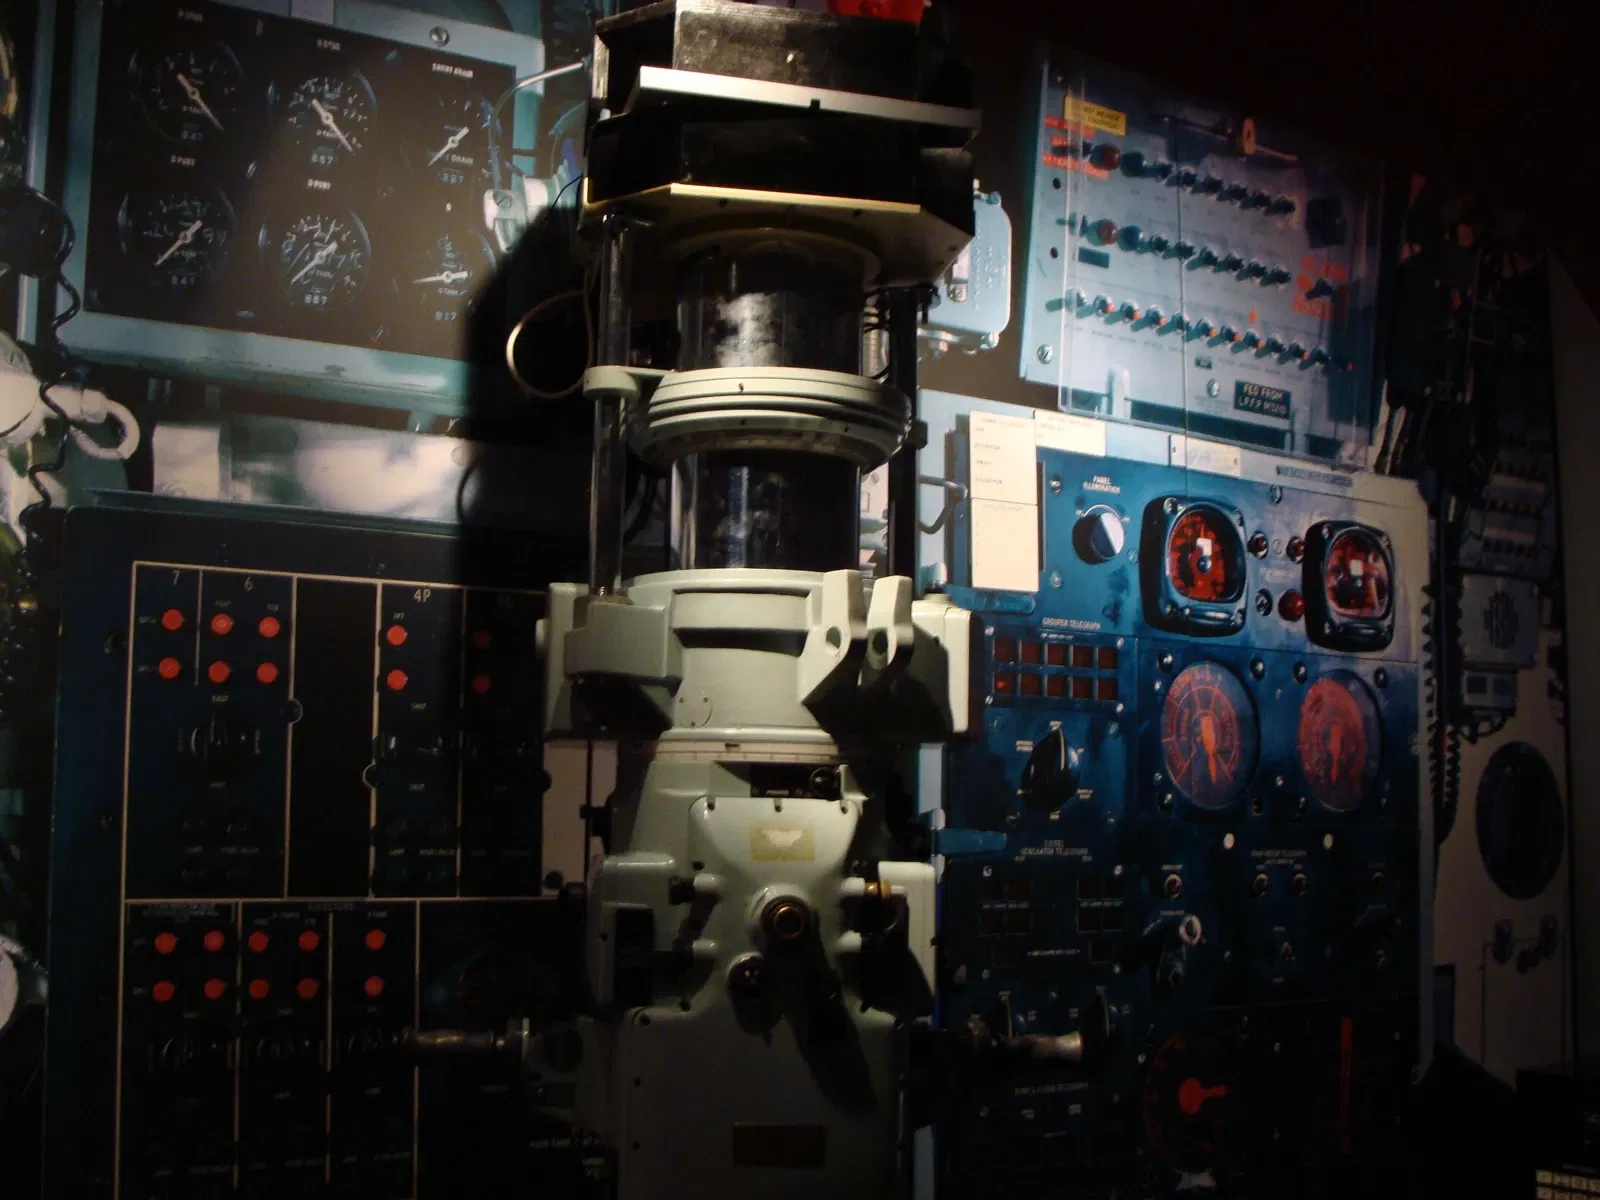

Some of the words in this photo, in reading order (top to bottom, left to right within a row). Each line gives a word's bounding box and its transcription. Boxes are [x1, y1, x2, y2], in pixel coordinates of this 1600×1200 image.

[172, 570, 180, 587] 7
[244, 576, 253, 592] 6
[413, 588, 431, 604] 4P
